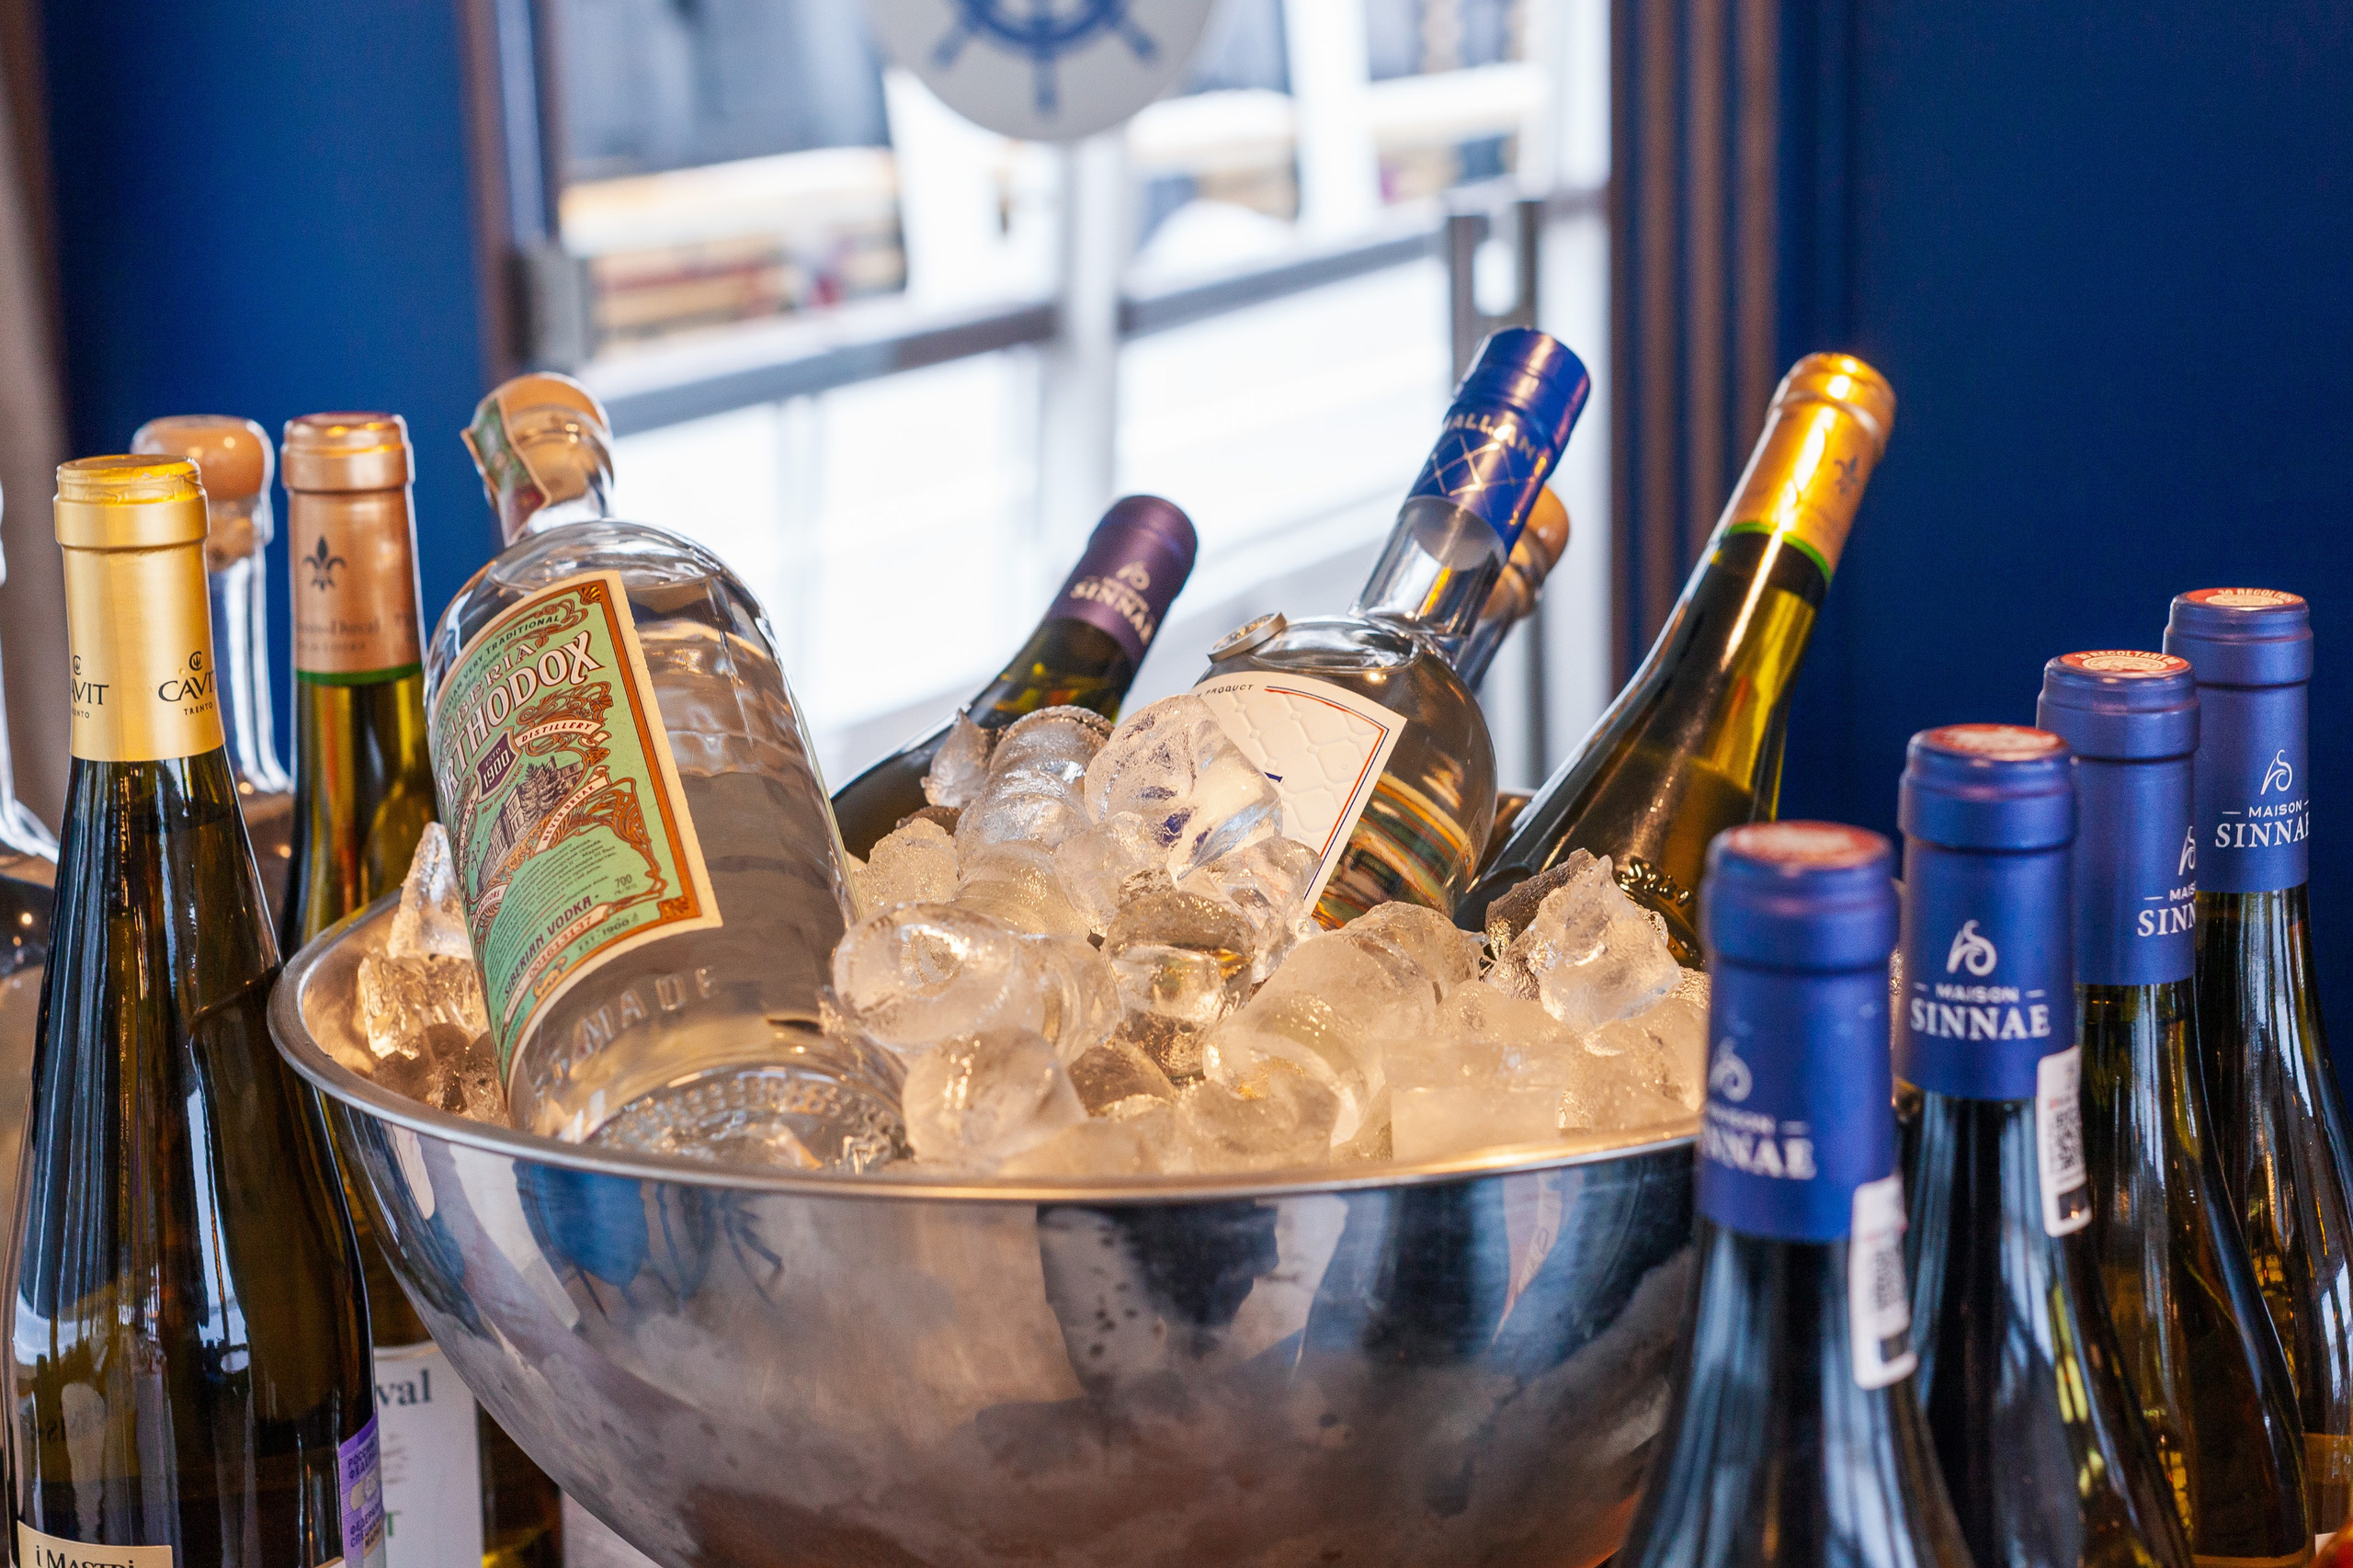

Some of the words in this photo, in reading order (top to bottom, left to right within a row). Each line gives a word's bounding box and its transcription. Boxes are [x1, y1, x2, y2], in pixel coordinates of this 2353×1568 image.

[463, 653, 483, 680] VERY
[484, 615, 560, 656] TRADITIONAL
[72, 678, 110, 706] AVIT
[158, 671, 214, 702] CAVI
[1205, 684, 1255, 697] PRODUCT
[184, 701, 214, 716] TRENTO
[521, 722, 593, 743] DISTILLERY
[483, 749, 510, 789] 1900
[542, 812, 564, 842] NEVER
[564, 785, 596, 810] BREAK
[2248, 799, 2302, 818] MAISON
[615, 873, 632, 888] 700
[2170, 881, 2196, 902] MAIS
[2137, 899, 2196, 937] SINN
[505, 933, 545, 999] SIBERIAN
[547, 894, 593, 936] VODKA
[1910, 1004, 2051, 1040] SINNAE
